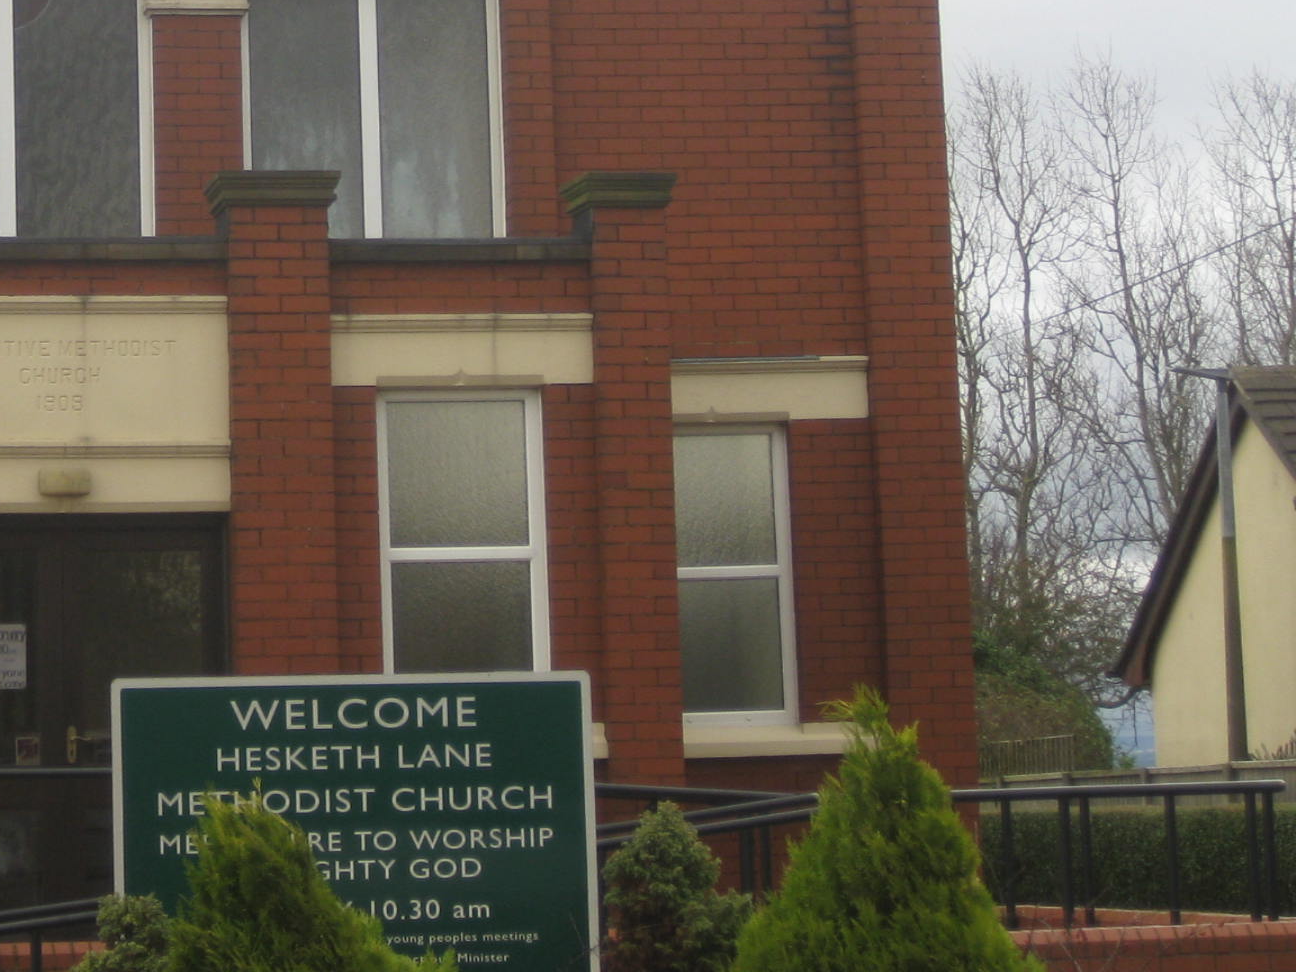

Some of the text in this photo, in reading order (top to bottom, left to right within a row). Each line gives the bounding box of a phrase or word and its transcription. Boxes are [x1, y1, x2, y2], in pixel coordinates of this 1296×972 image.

[58, 339, 177, 357] METHODIST
[19, 367, 101, 384] CHURCH
[230, 696, 478, 730] WELCOME
[216, 743, 493, 772] HESKETH LANE
[157, 785, 554, 816] METHODIST CHURCH
[353, 830, 397, 851] TO
[409, 827, 554, 850] WORSHIP
[314, 858, 482, 880] GHTY GOD
[370, 899, 441, 921] 10.30
[452, 903, 491, 919] am
[386, 931, 539, 946] young peoples meetings
[457, 952, 510, 964] Minister
